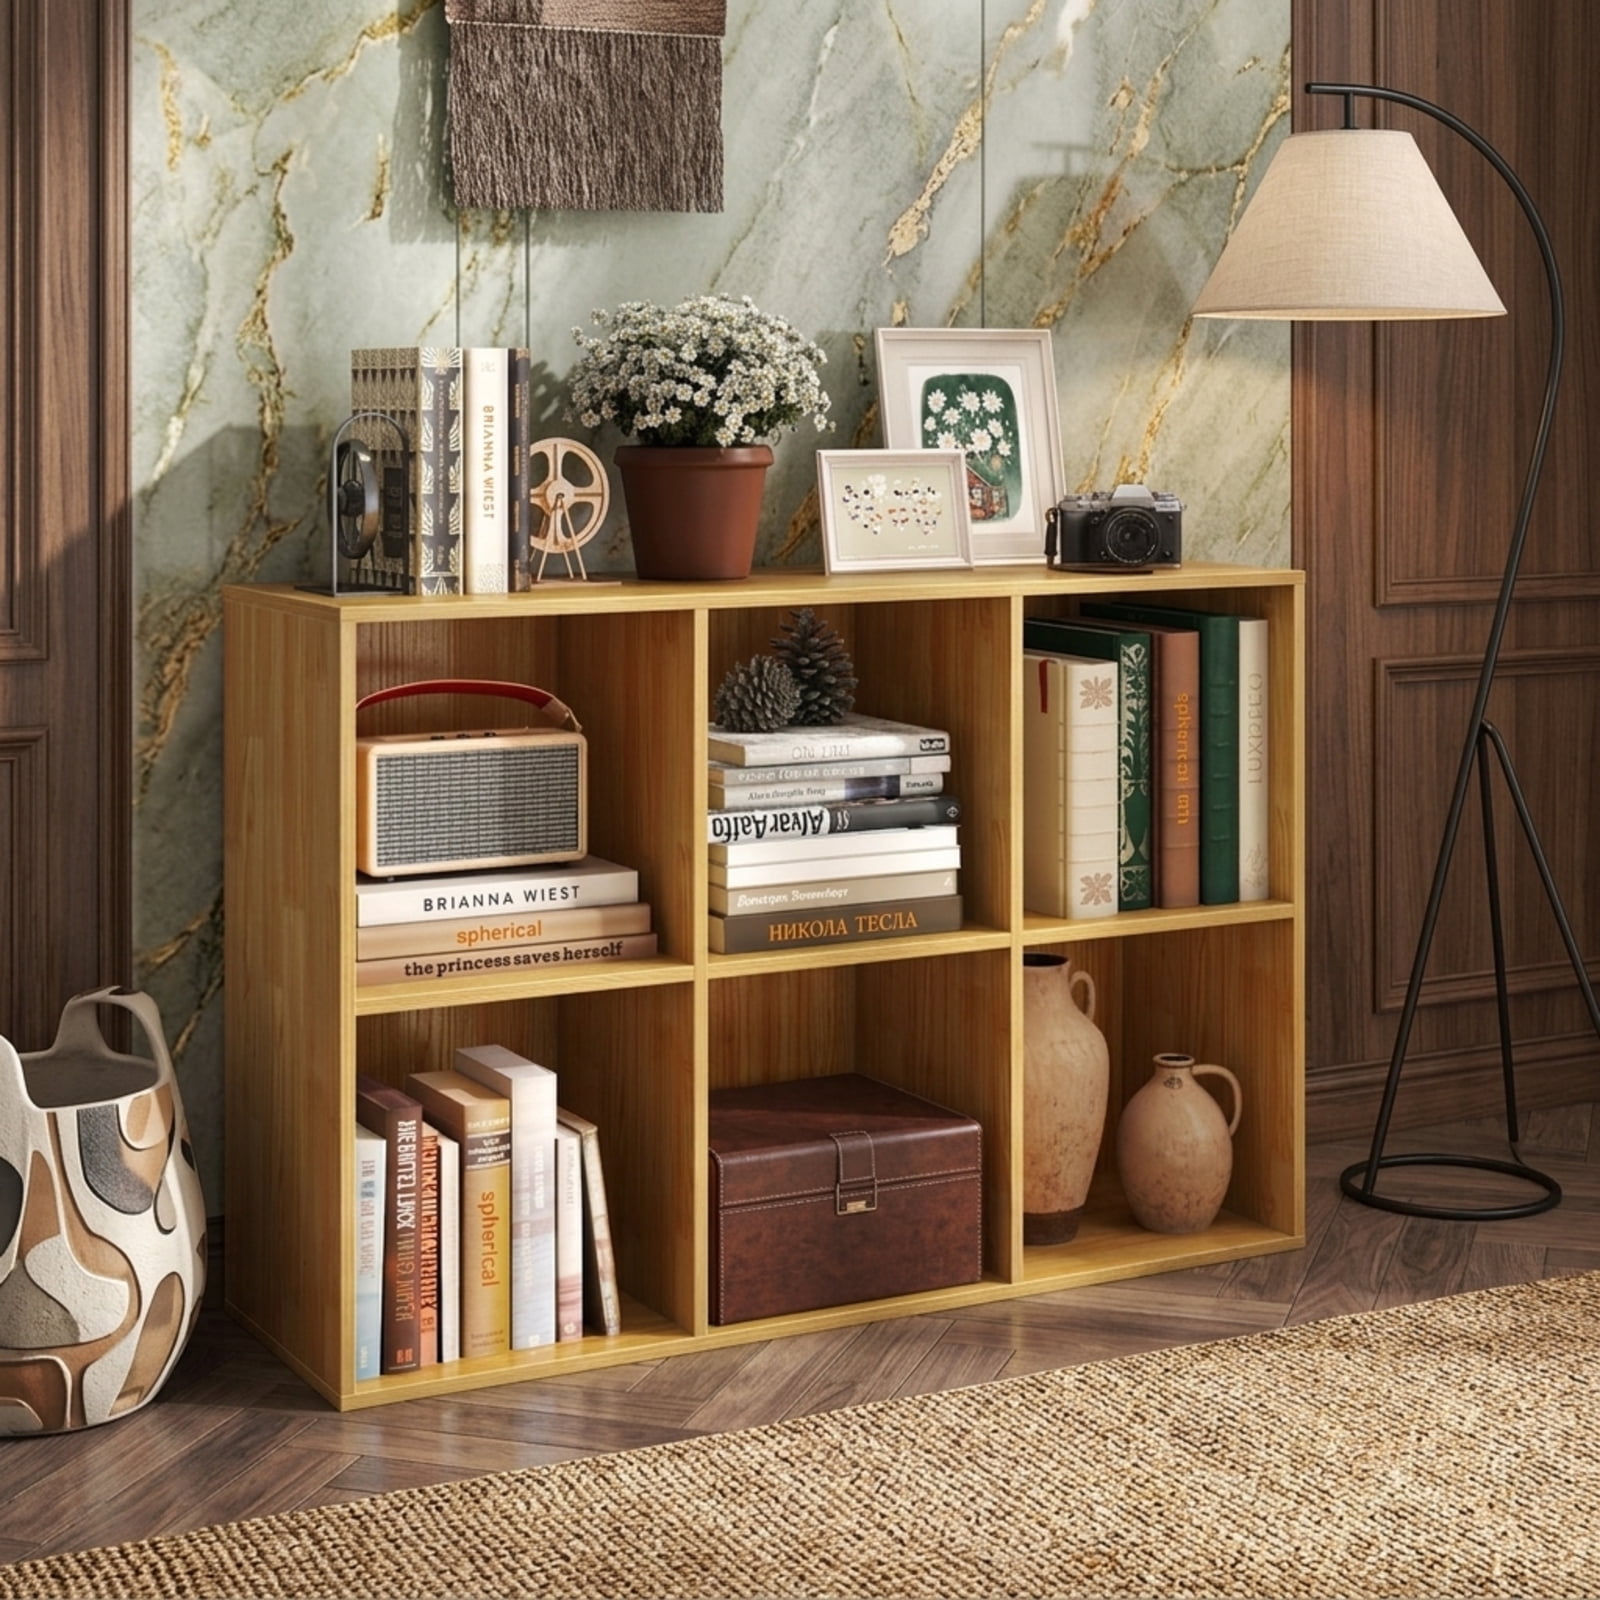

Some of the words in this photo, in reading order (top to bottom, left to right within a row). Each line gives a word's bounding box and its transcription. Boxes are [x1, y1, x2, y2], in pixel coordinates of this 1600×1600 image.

[483, 405, 494, 472] BRIANNA
[423, 892, 514, 912] BRIANNA
[523, 885, 580, 903] WIEST
[456, 919, 542, 947] spherical
[767, 918, 848, 942] НИКОЛА
[854, 911, 919, 934] ТЕСЛА
[404, 962, 434, 977] the
[436, 954, 511, 978] princess
[513, 951, 561, 966] saves
[563, 940, 623, 961] herself
[478, 1190, 501, 1288] spherical
